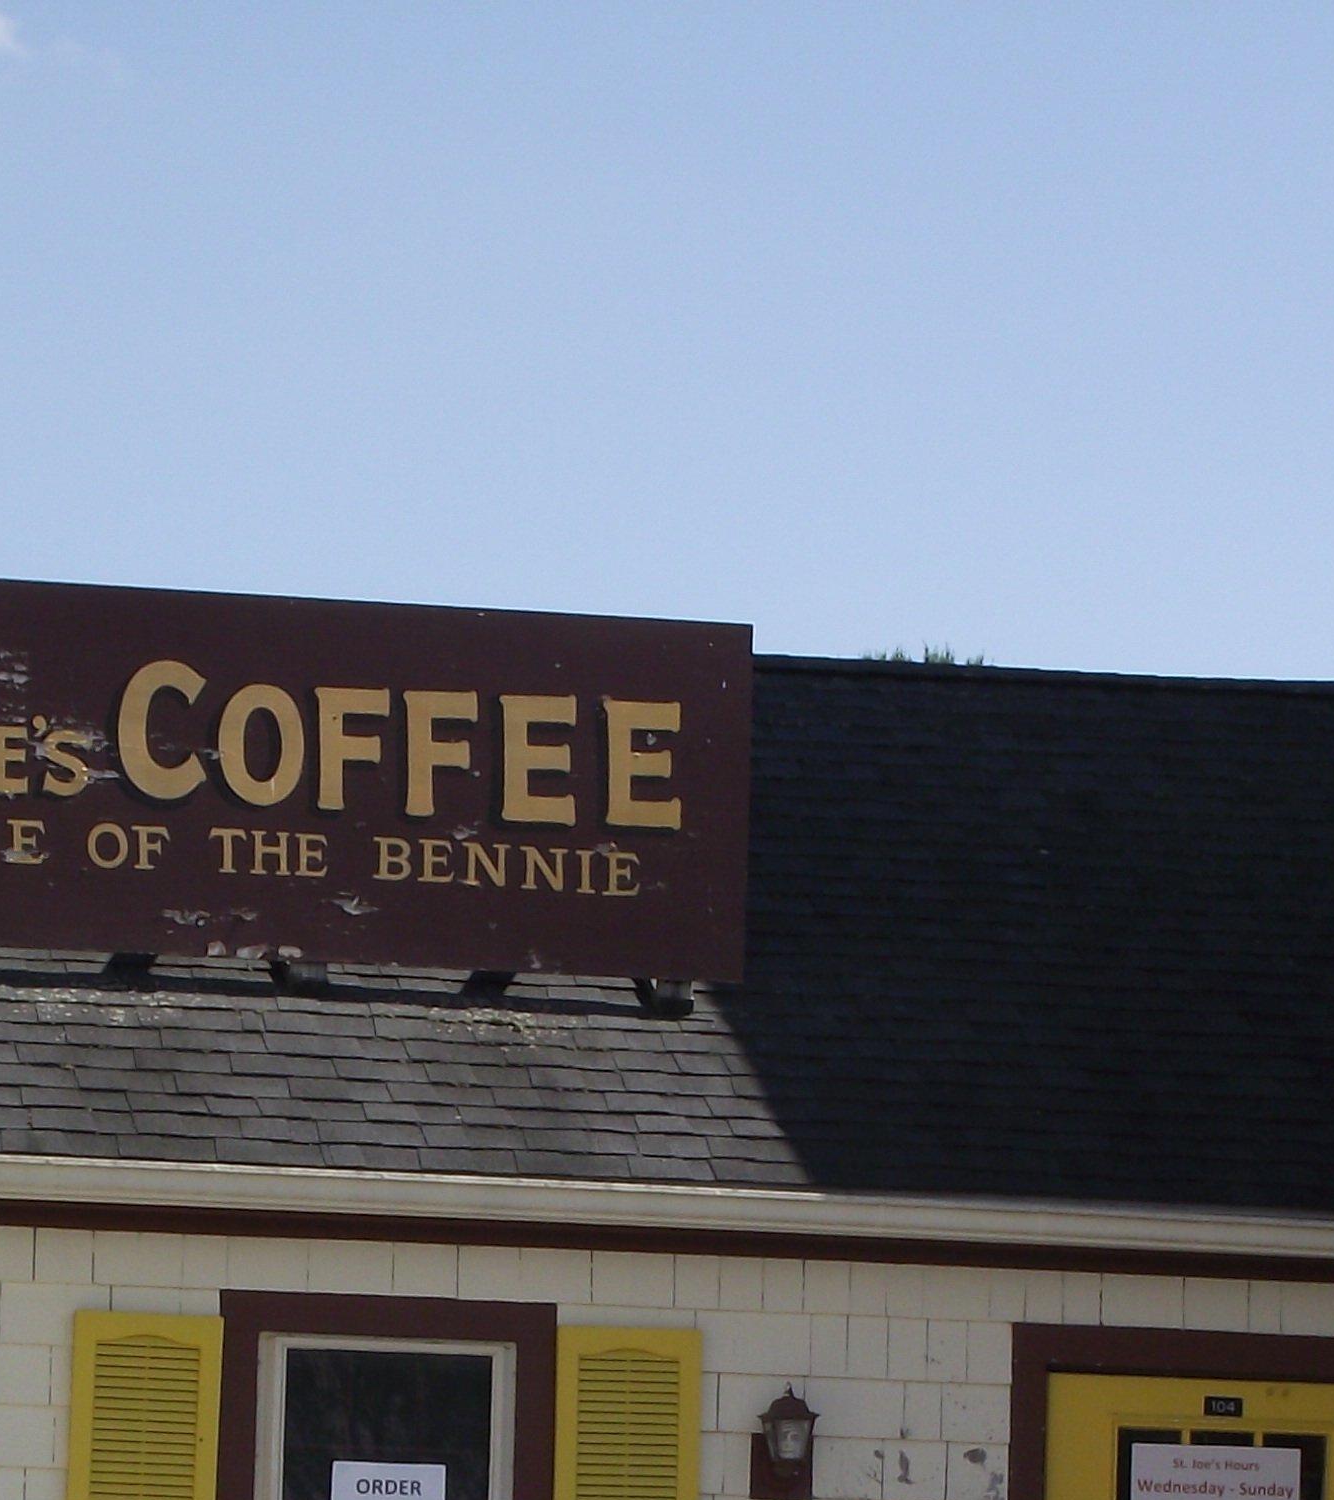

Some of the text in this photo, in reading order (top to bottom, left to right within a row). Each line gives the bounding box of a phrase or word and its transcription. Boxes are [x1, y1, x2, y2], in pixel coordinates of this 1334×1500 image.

[117, 659, 683, 831] COFFEE
[85, 821, 173, 871] OF
[209, 826, 330, 879] THE
[373, 835, 642, 898] BENNIE
[1210, 1399, 1236, 1414] 104
[1191, 1458, 1221, 1471] Joe's
[1224, 1459, 1260, 1472] Hours
[355, 1477, 423, 1497] ORDER
[1137, 1478, 1226, 1498] Wednesday
[1238, 1481, 1294, 1500] Sunday
